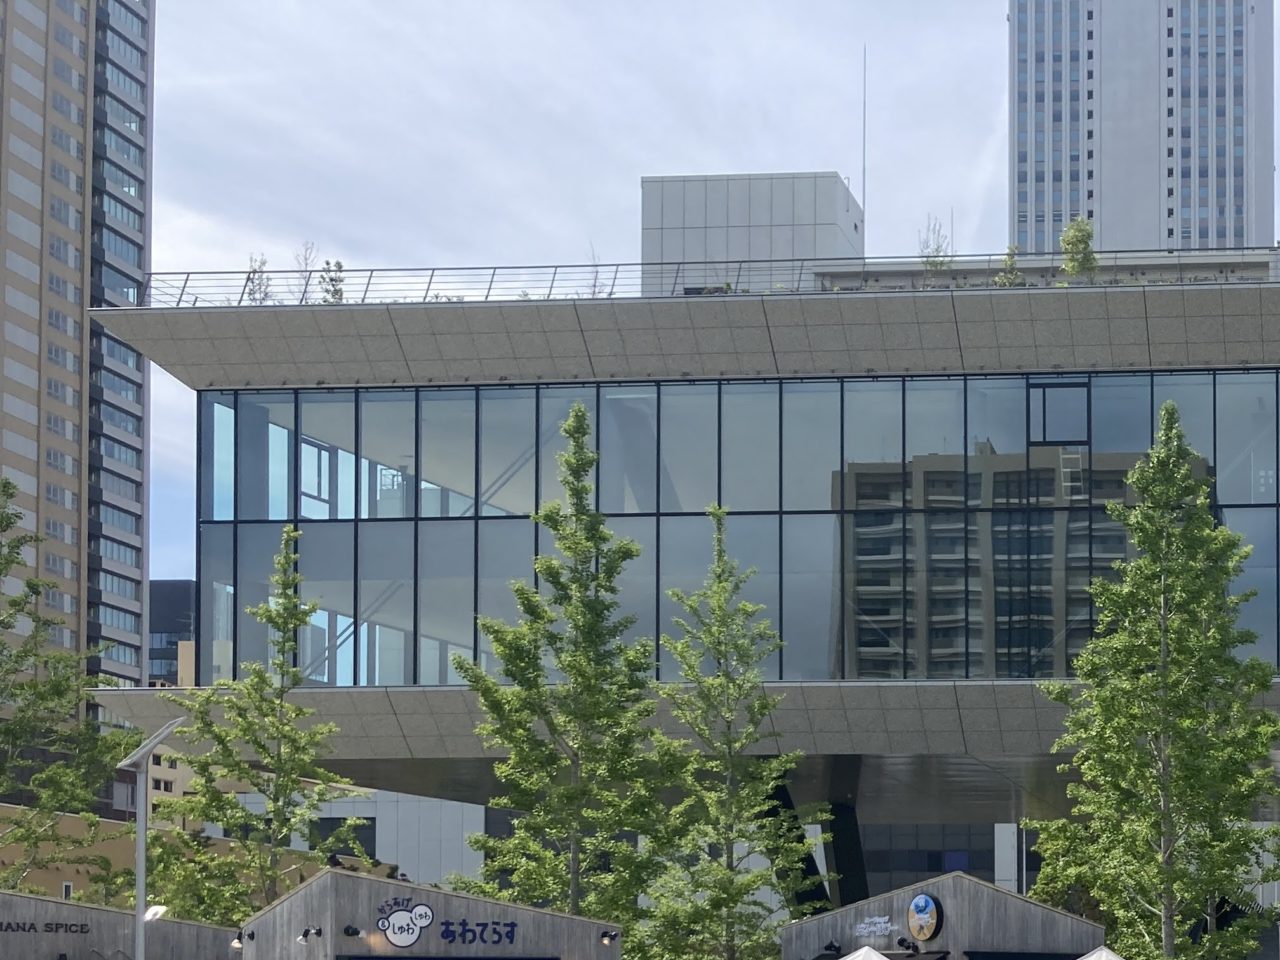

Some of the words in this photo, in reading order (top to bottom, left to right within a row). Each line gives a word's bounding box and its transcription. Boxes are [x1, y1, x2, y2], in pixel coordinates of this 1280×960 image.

[44, 922, 90, 934] SPICE
[392, 922, 415, 936] しゅわ
[440, 918, 518, 945] あわてらす
